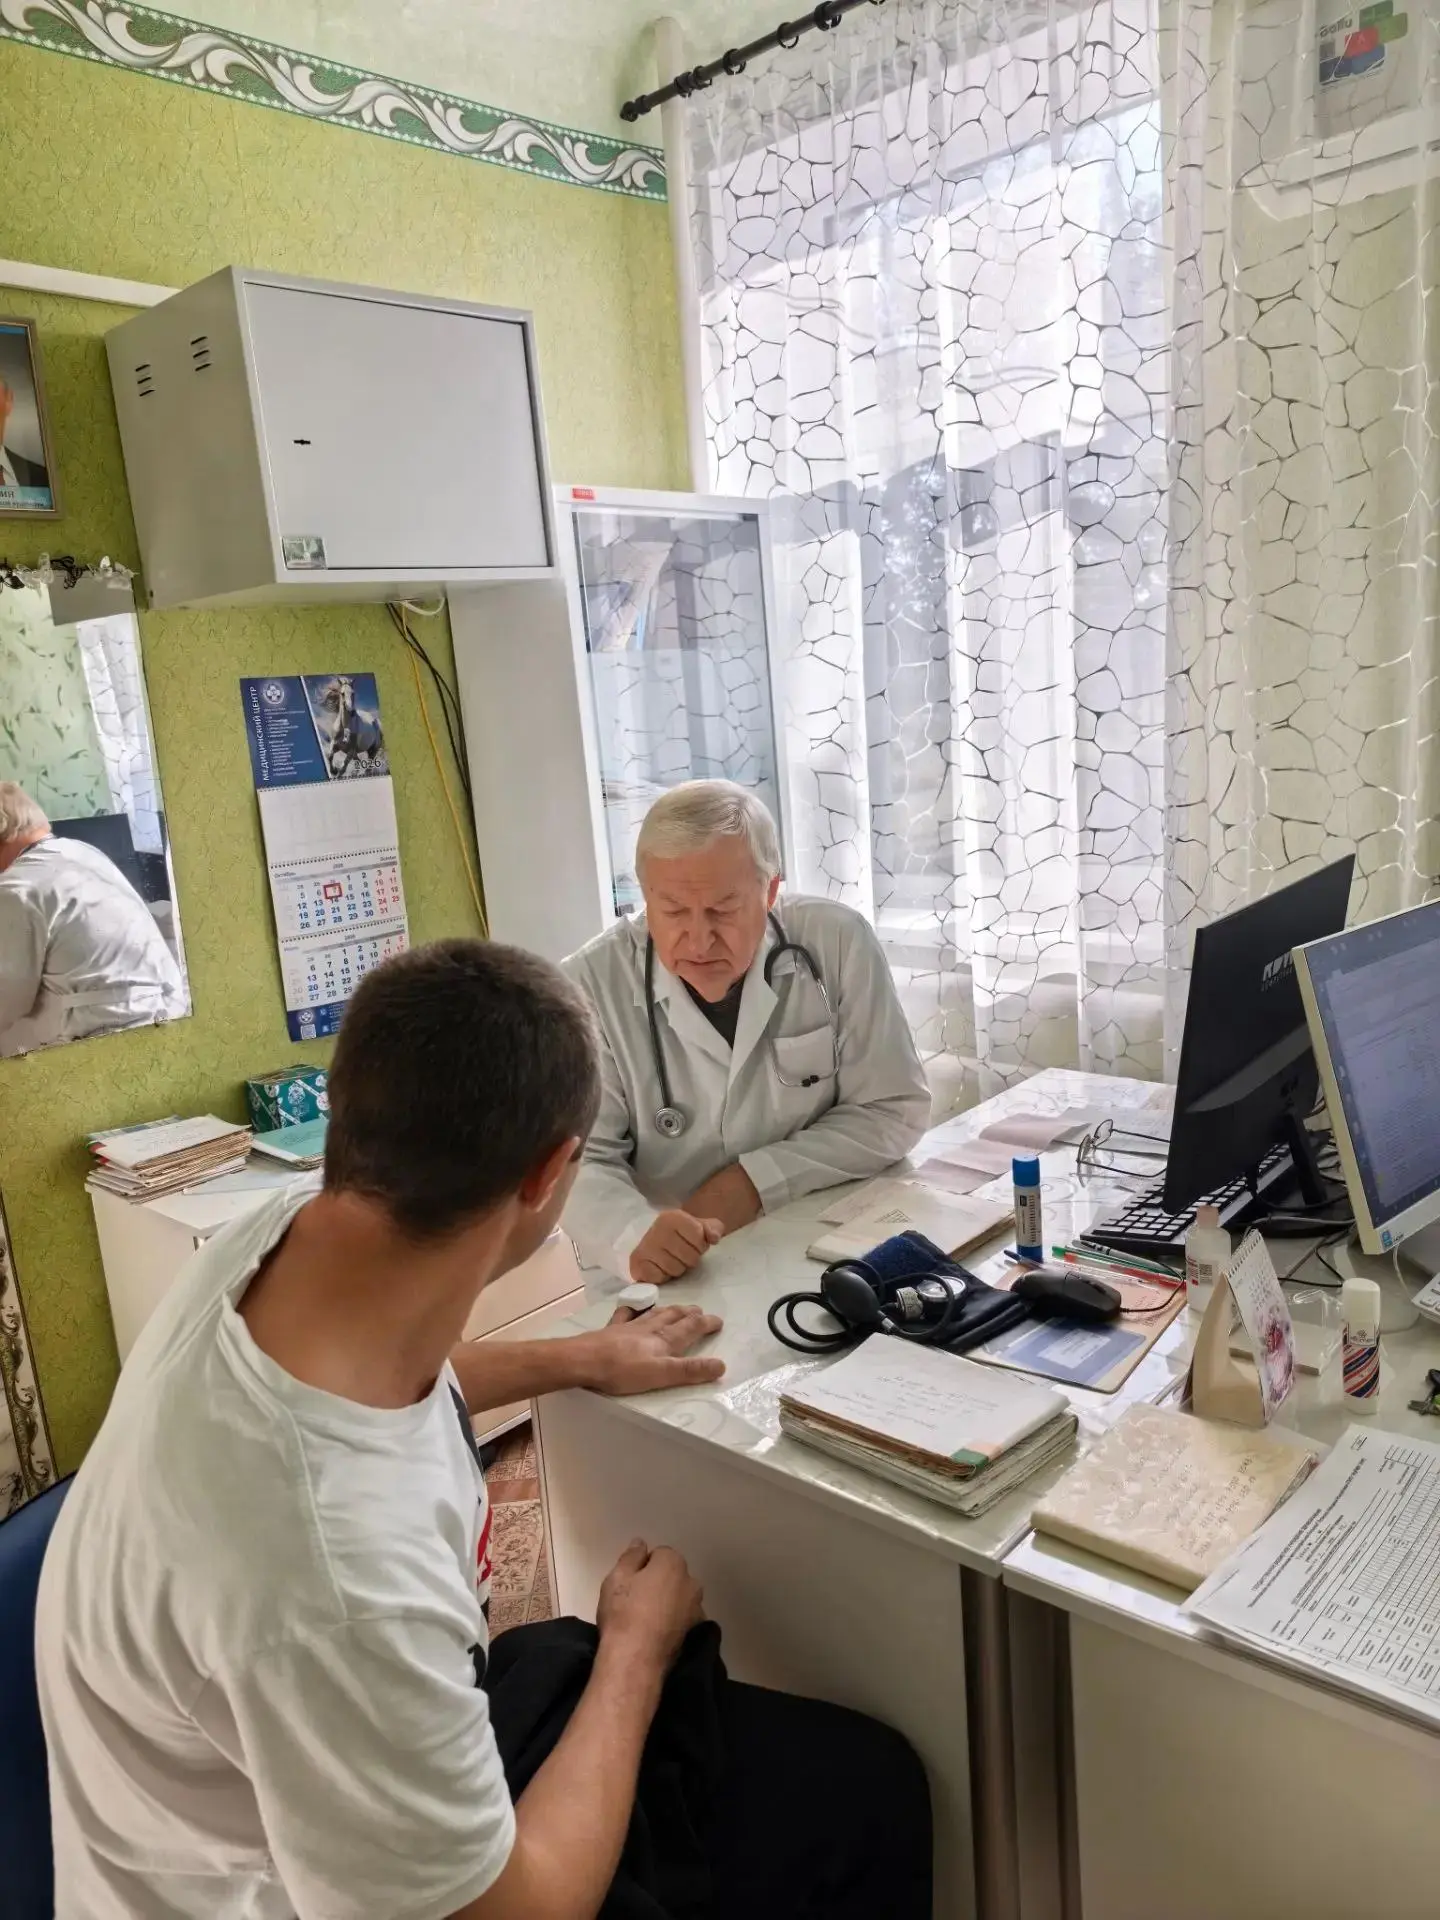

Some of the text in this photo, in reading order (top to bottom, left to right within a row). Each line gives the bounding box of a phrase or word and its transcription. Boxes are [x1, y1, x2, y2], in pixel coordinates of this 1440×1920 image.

[250, 686, 261, 714] ЦЕНТР
[252, 715, 270, 781] МЕДИЦИНСКИЙ
[354, 759, 381, 770] 2026
[299, 912, 309, 920] 19
[300, 922, 310, 930] 26
[309, 993, 319, 1001] 27
[327, 990, 336, 998] 28
